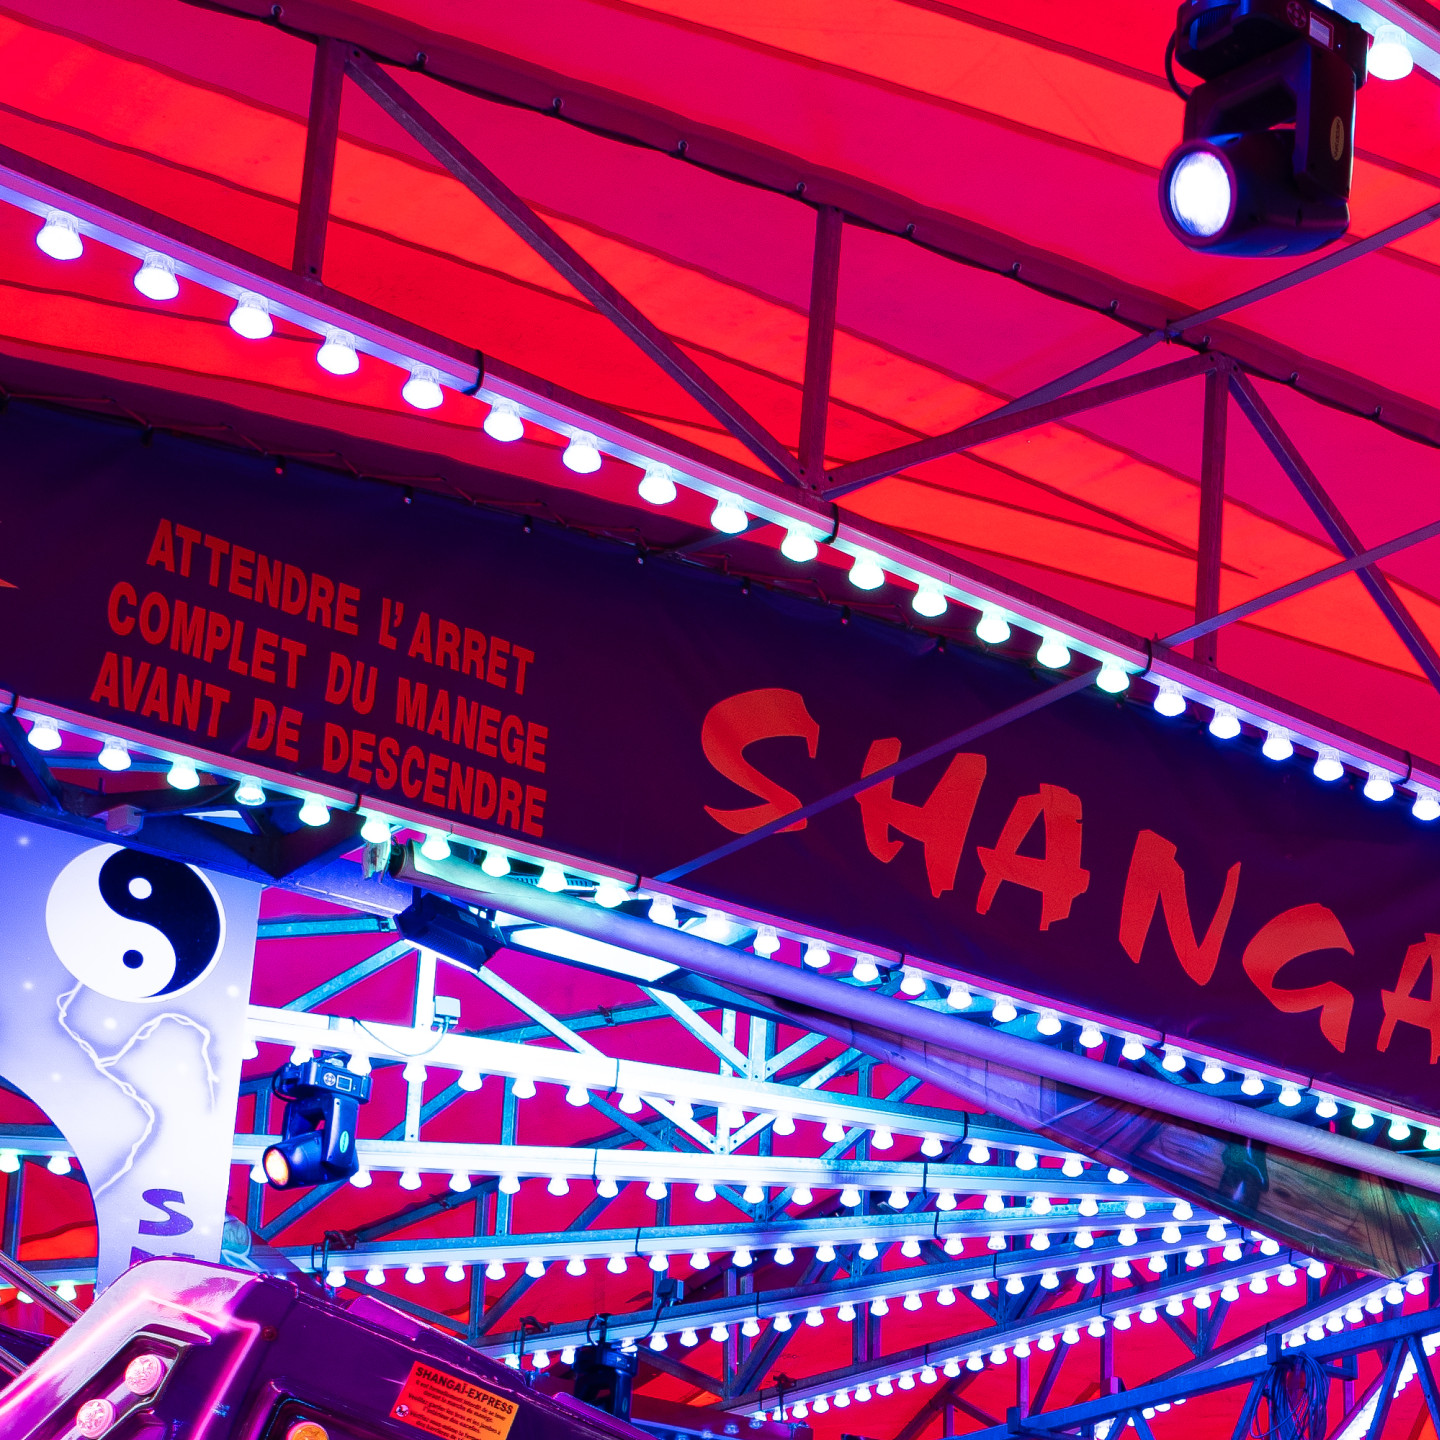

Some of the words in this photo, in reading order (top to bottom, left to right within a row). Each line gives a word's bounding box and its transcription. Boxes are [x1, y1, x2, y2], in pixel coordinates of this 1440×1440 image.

[107, 581, 307, 689] COMPLET
[325, 651, 378, 715] DU
[396, 676, 549, 774] MANEGE
[146, 518, 361, 636] ATTENDRE
[379, 597, 535, 696] L'ARRET
[91, 651, 230, 738] AVANT
[247, 700, 304, 763] DE
[323, 721, 547, 838] DESCENDRE
[415, 1366, 514, 1415] SHANGAÏ-EXPRESS
